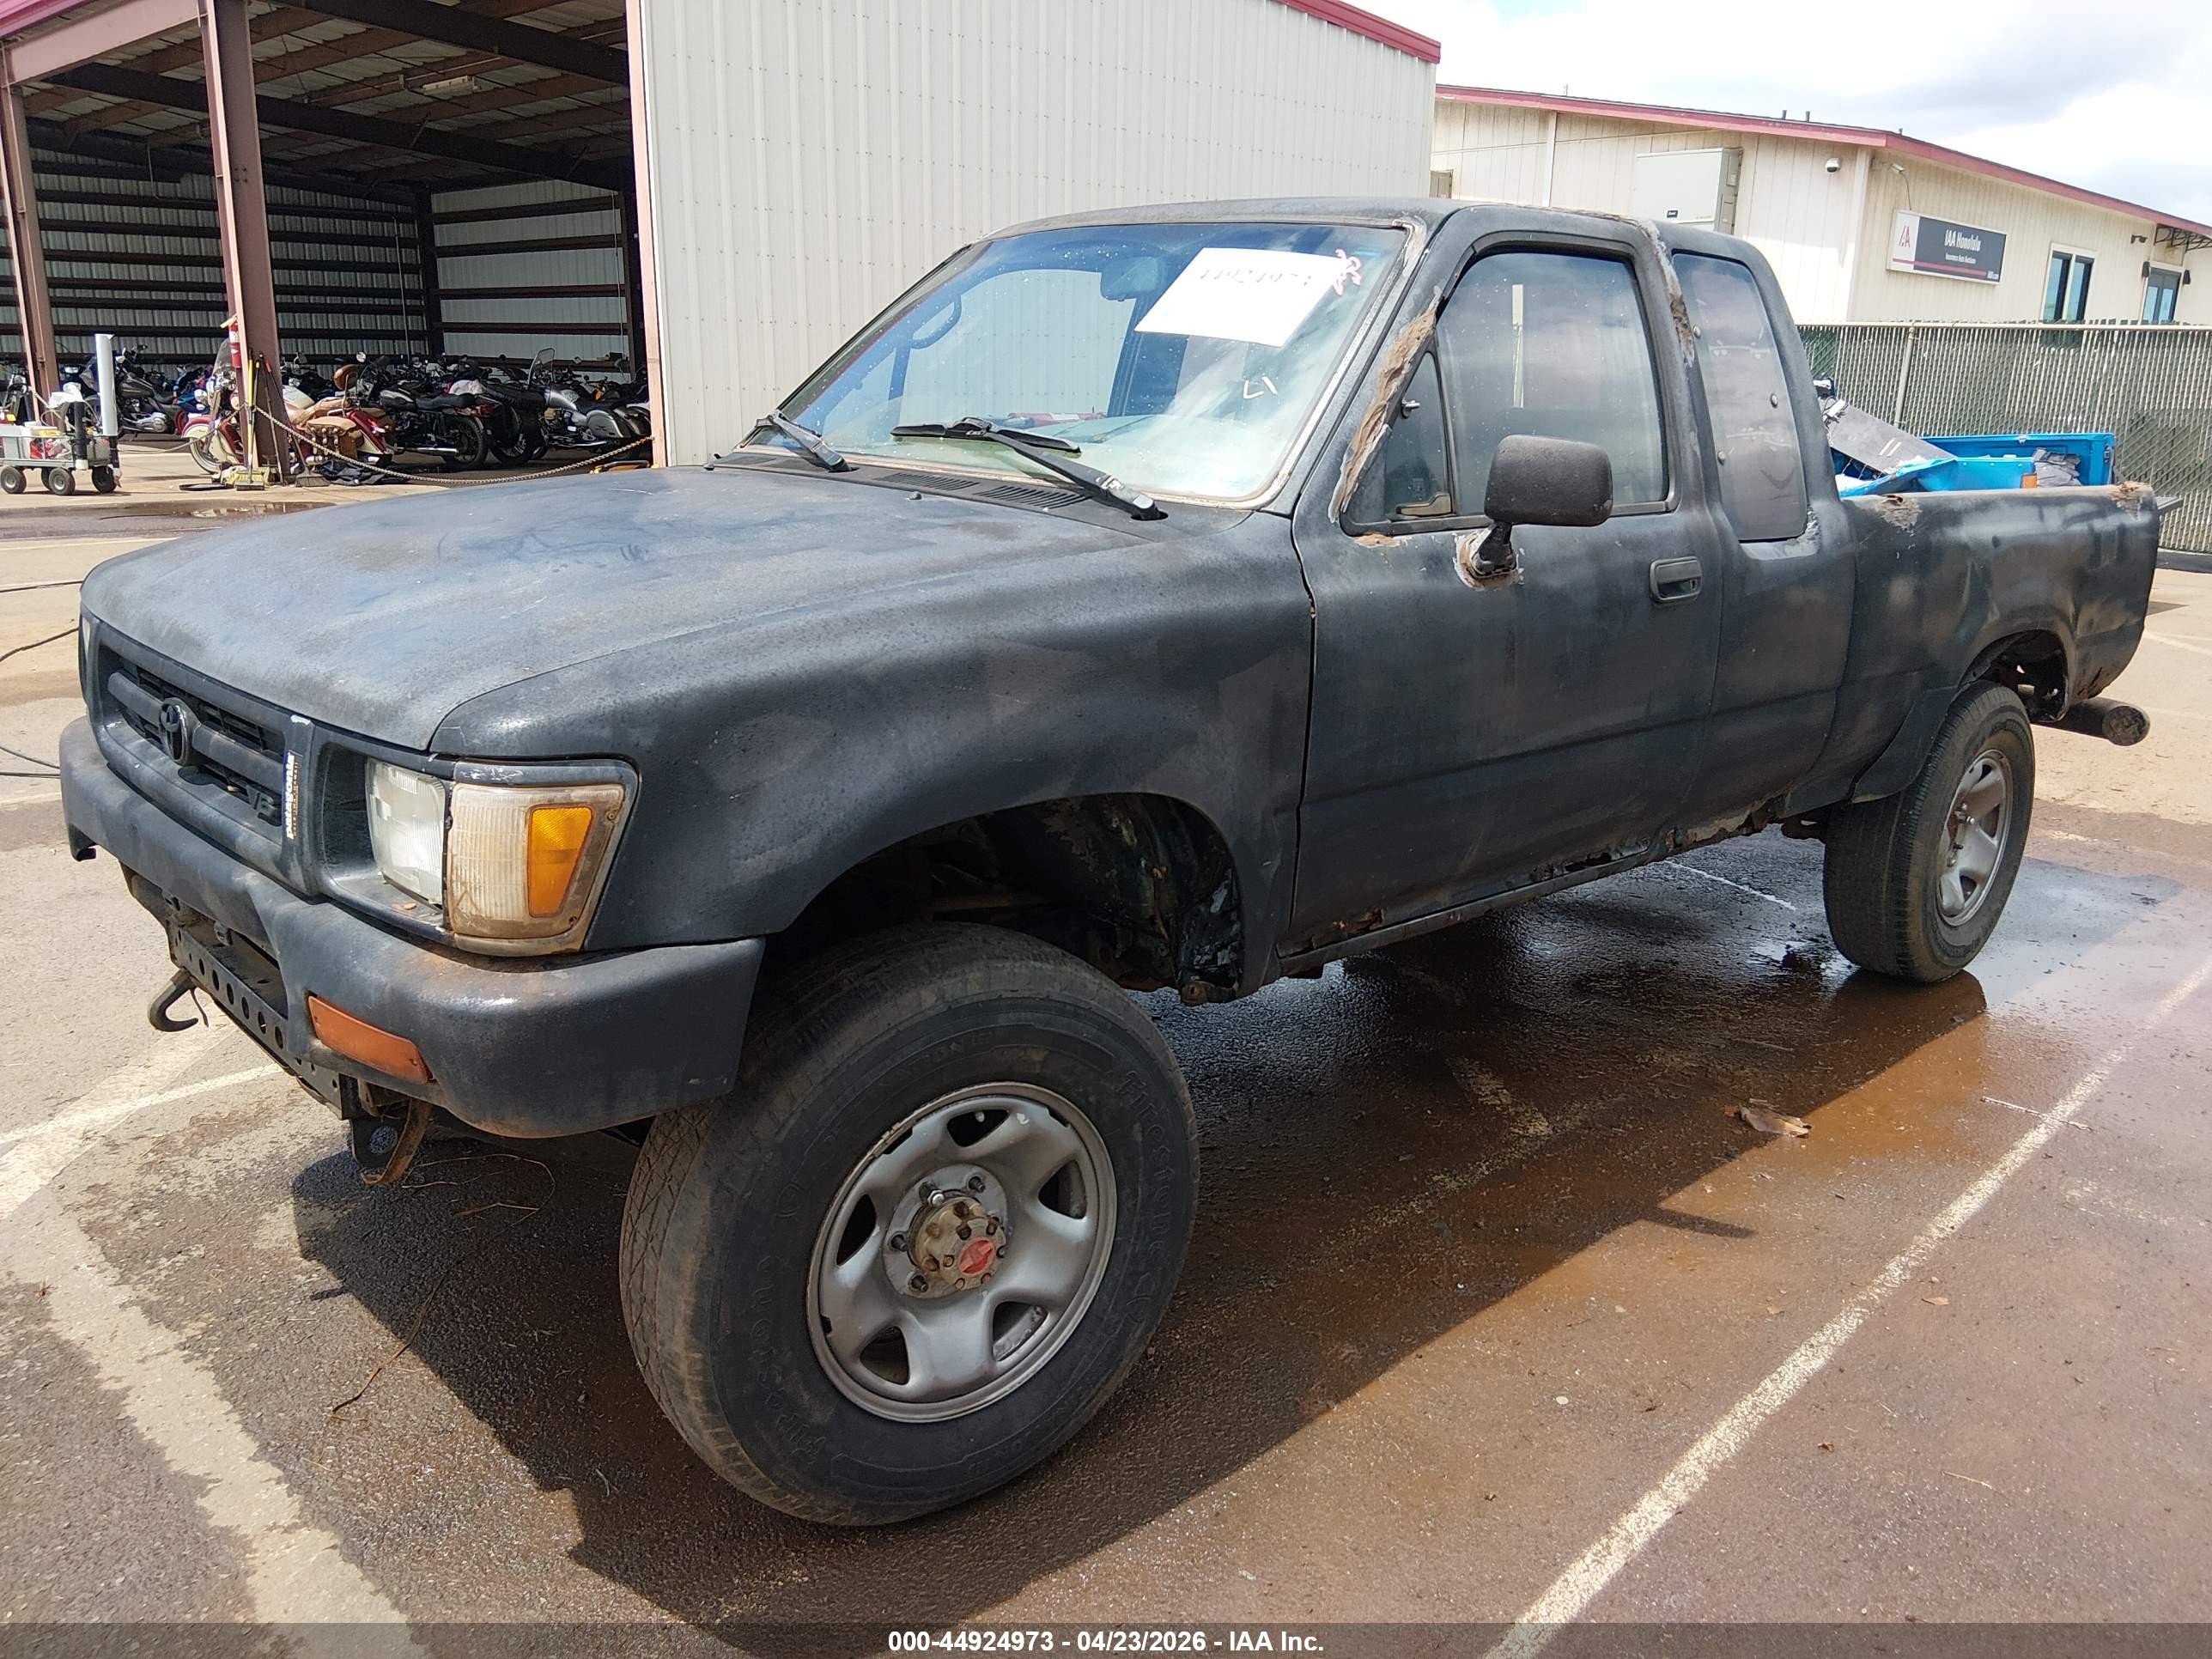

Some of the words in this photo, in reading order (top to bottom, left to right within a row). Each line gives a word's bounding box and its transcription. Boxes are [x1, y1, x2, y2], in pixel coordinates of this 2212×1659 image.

[1944, 229, 1957, 247] IAA
[246, 784, 281, 827] V6
[285, 752, 295, 840] patagonia
